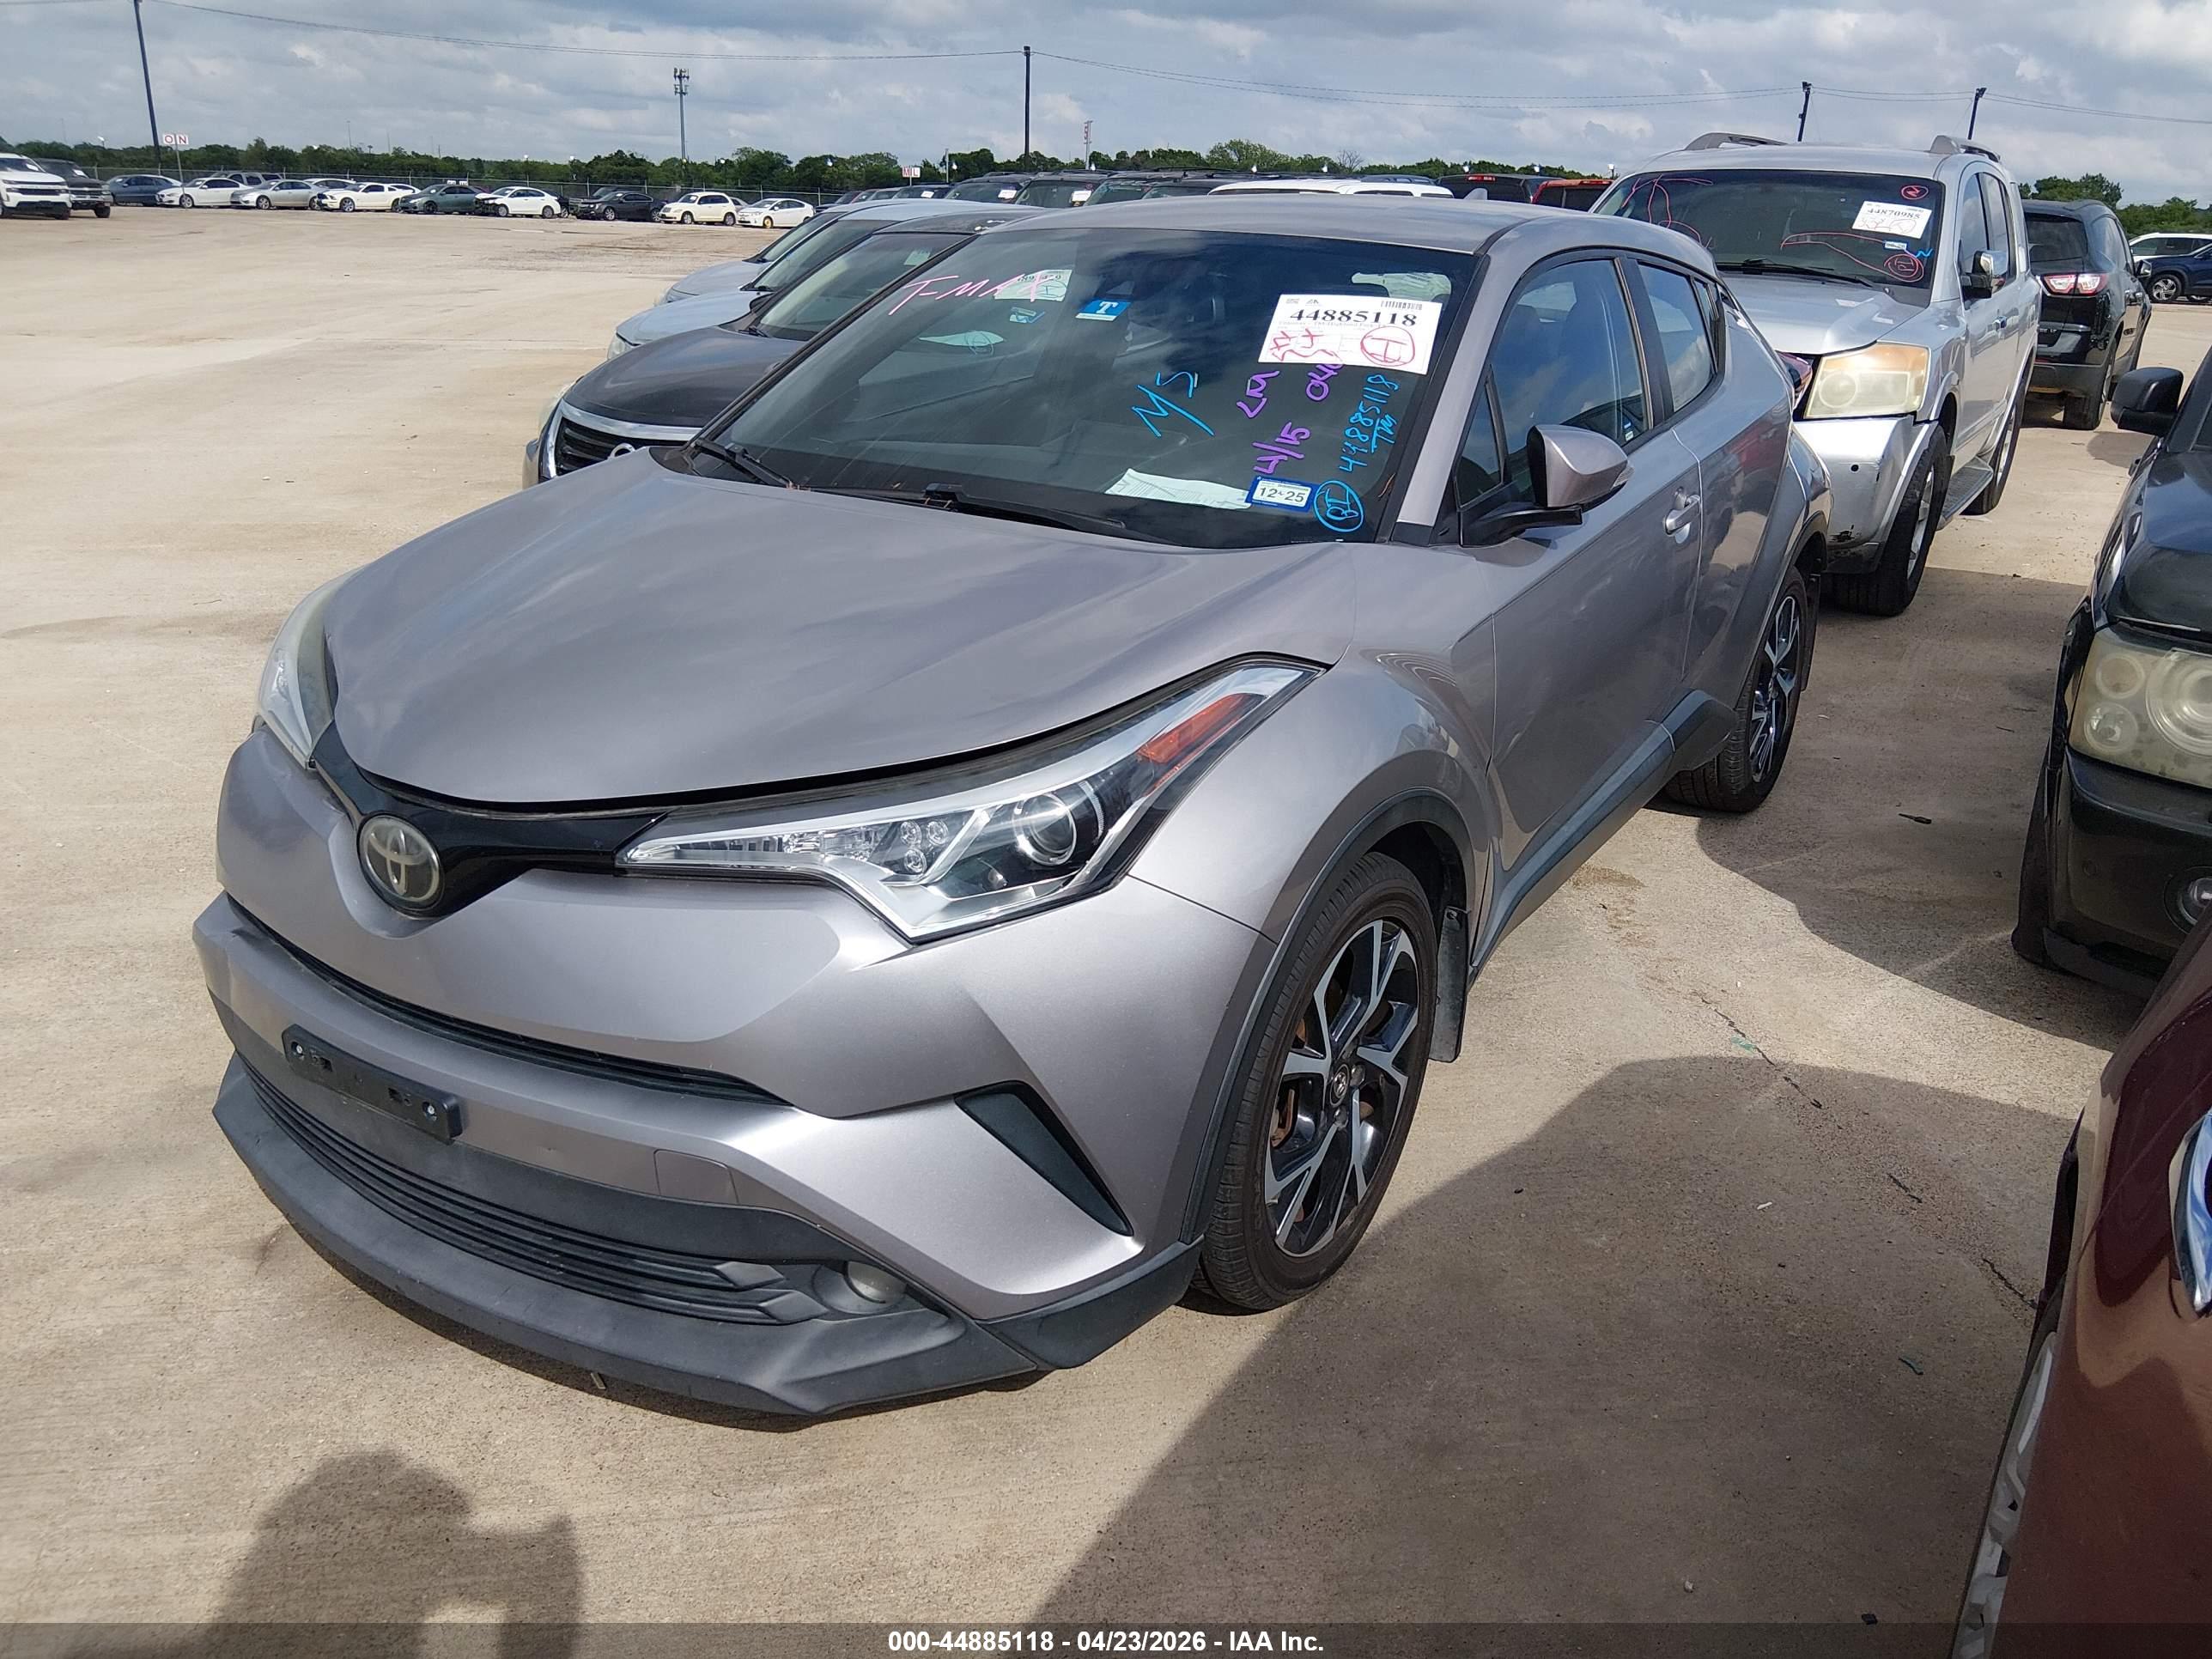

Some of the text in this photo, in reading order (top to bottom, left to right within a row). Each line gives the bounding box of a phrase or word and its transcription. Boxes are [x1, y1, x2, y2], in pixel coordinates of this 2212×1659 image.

[1290, 308, 1418, 327] 44885118
[1259, 487, 1306, 502] 12 25
